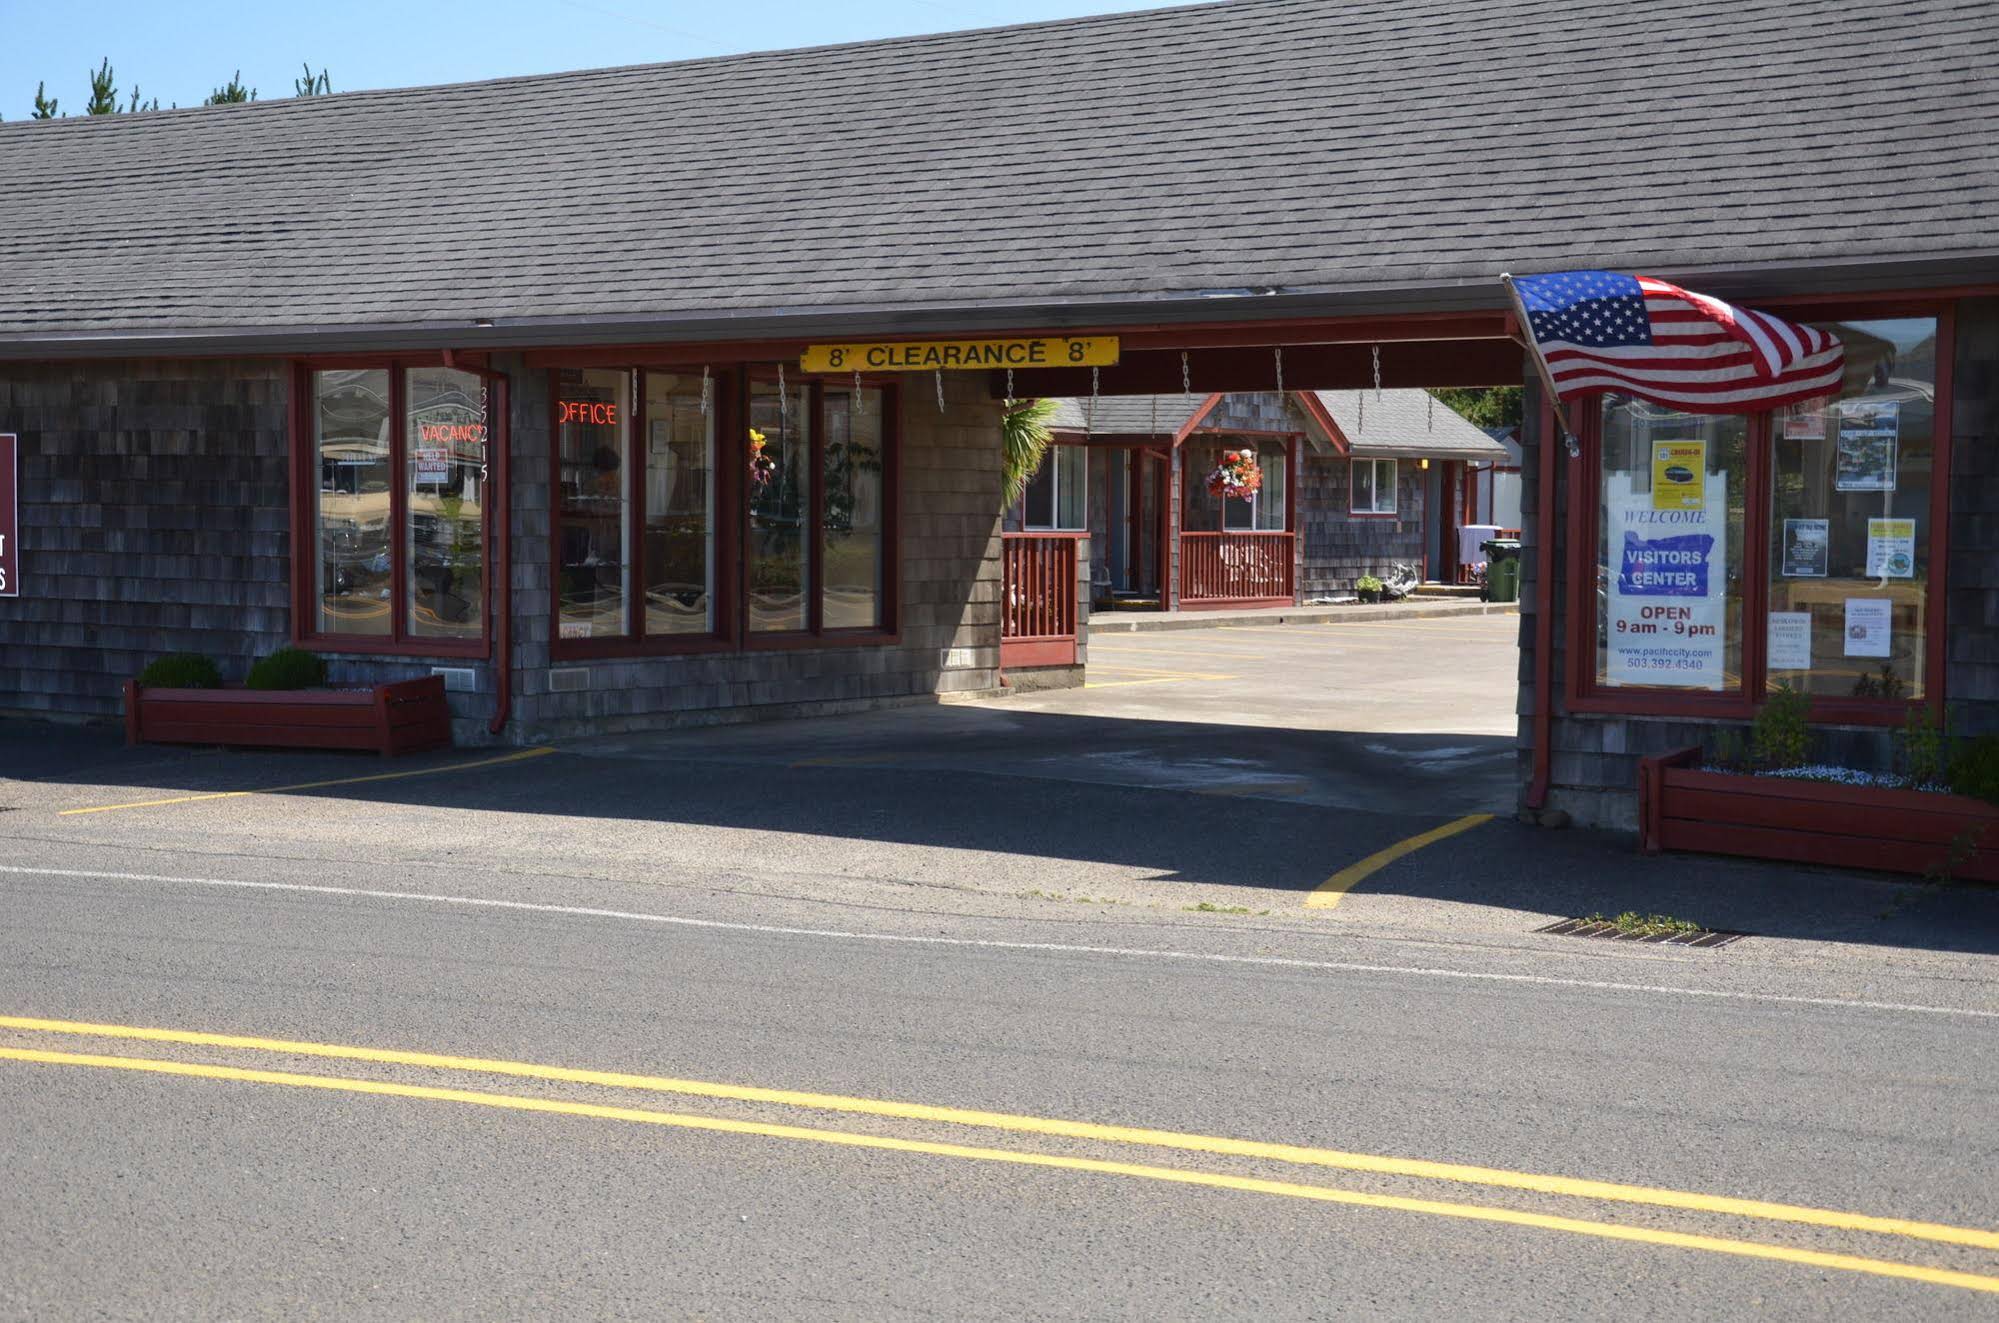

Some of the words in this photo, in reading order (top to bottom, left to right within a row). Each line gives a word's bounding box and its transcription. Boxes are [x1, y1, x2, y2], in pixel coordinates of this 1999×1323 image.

[829, 347, 851, 368] 8'
[866, 341, 1047, 367] CLEARANCE
[1068, 341, 1094, 363] 8'
[480, 386, 488, 482] 35215
[423, 451, 440, 461] HELP
[418, 462, 446, 473] WANTED
[1624, 511, 1707, 524] WELCOME
[1626, 550, 1702, 565] VISITORS
[1632, 571, 1697, 586] CENTER
[1640, 606, 1691, 620] OPEN
[1617, 648, 1712, 658] www.pacificcity.com
[1627, 658, 1704, 671] 503.392.4340
